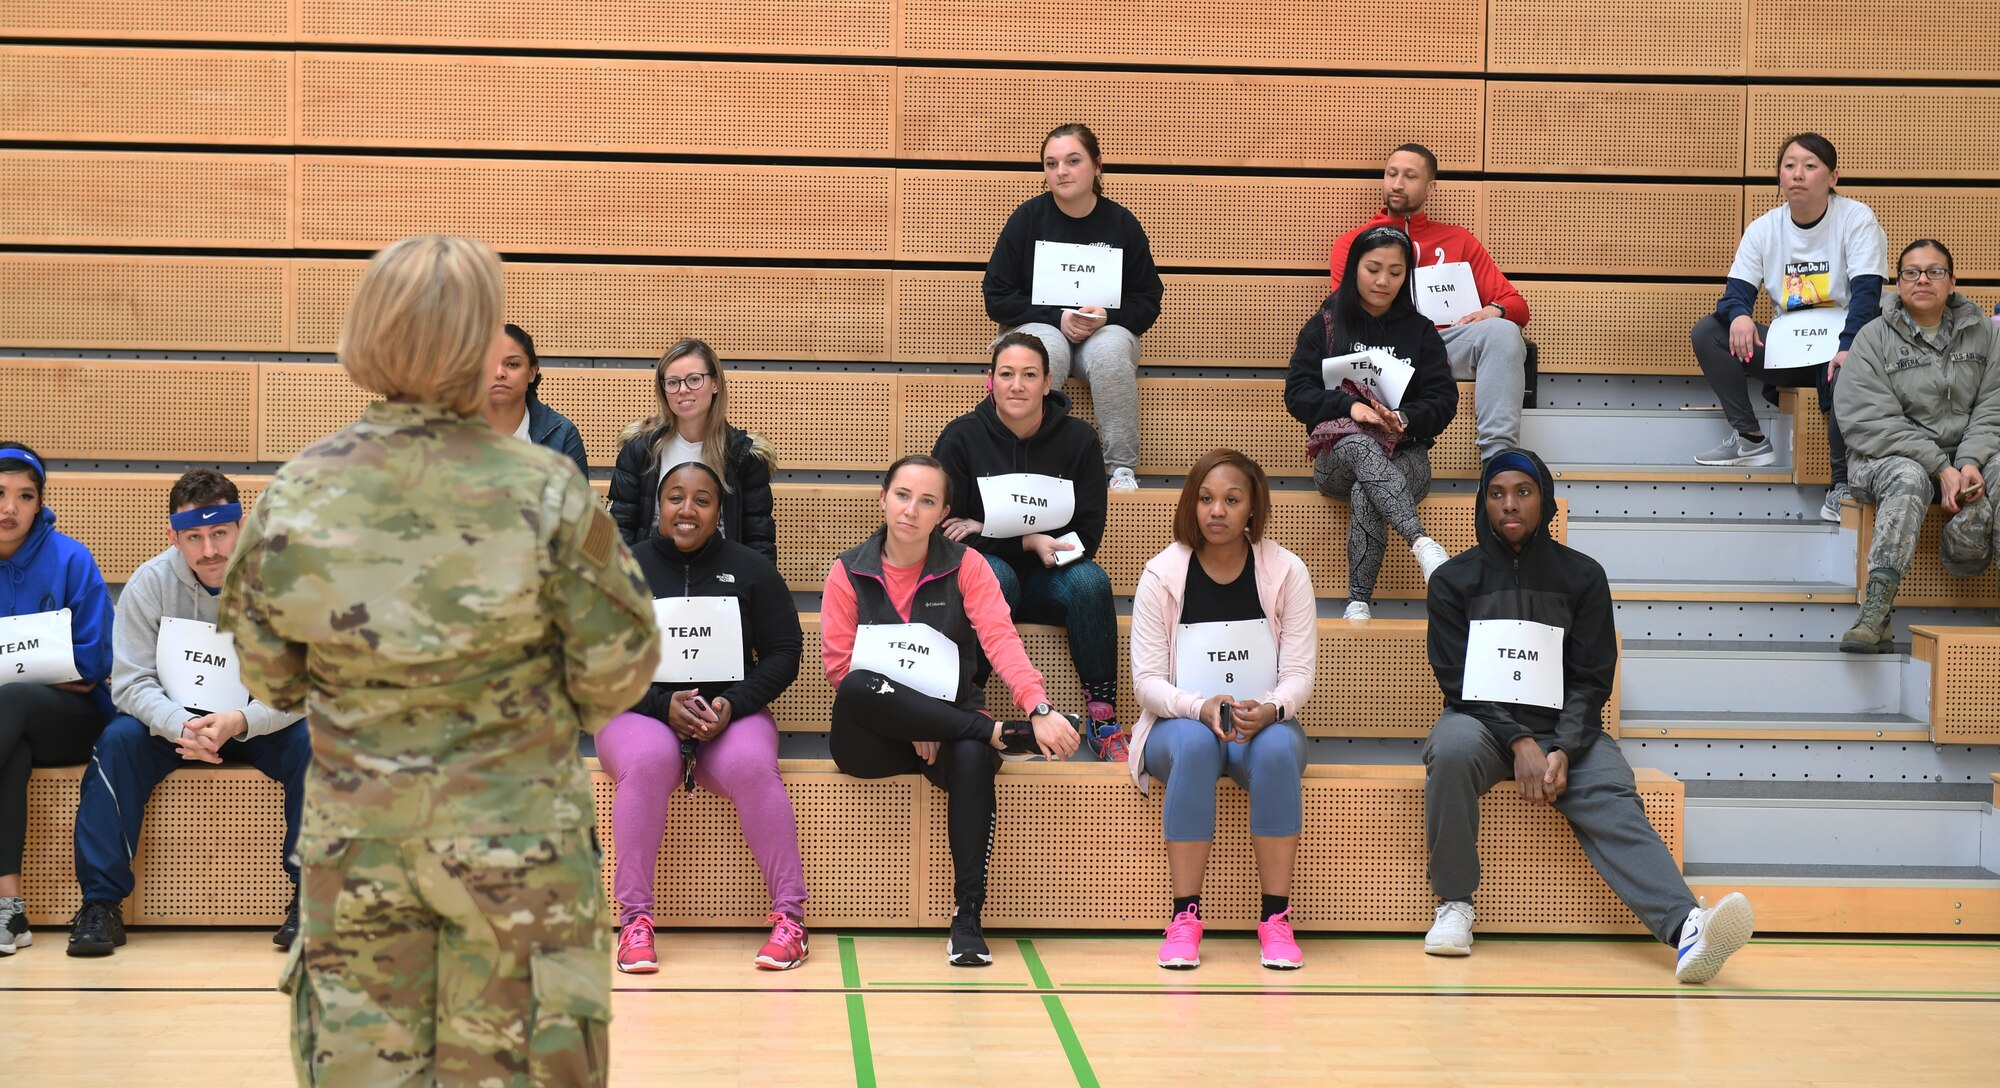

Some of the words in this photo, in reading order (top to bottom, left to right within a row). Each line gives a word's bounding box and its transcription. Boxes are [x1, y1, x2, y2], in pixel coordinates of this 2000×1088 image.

[1060, 264, 1095, 273] TEAM
[1797, 263, 1808, 273] Can
[1808, 262, 1819, 272] Do
[1820, 262, 1828, 272] It!
[1074, 281, 1079, 289] 1
[1428, 285, 1455, 293] TEAM
[1792, 329, 1827, 337] TEAM
[1350, 361, 1383, 377] TEAM
[1362, 377, 1377, 387] 18
[1011, 494, 1047, 508] TEAM
[1022, 515, 1035, 526] 18
[668, 627, 711, 638] TEAM
[681, 649, 699, 660] 17
[889, 642, 929, 656] TEAM
[184, 651, 226, 668] TEAM
[1207, 650, 1248, 662] TEAM
[1497, 648, 1538, 662] TEAM
[15, 662, 26, 674] 2
[898, 659, 915, 670] 17
[194, 675, 204, 686] 2
[1225, 673, 1233, 684] 8
[1513, 671, 1521, 681] 8
